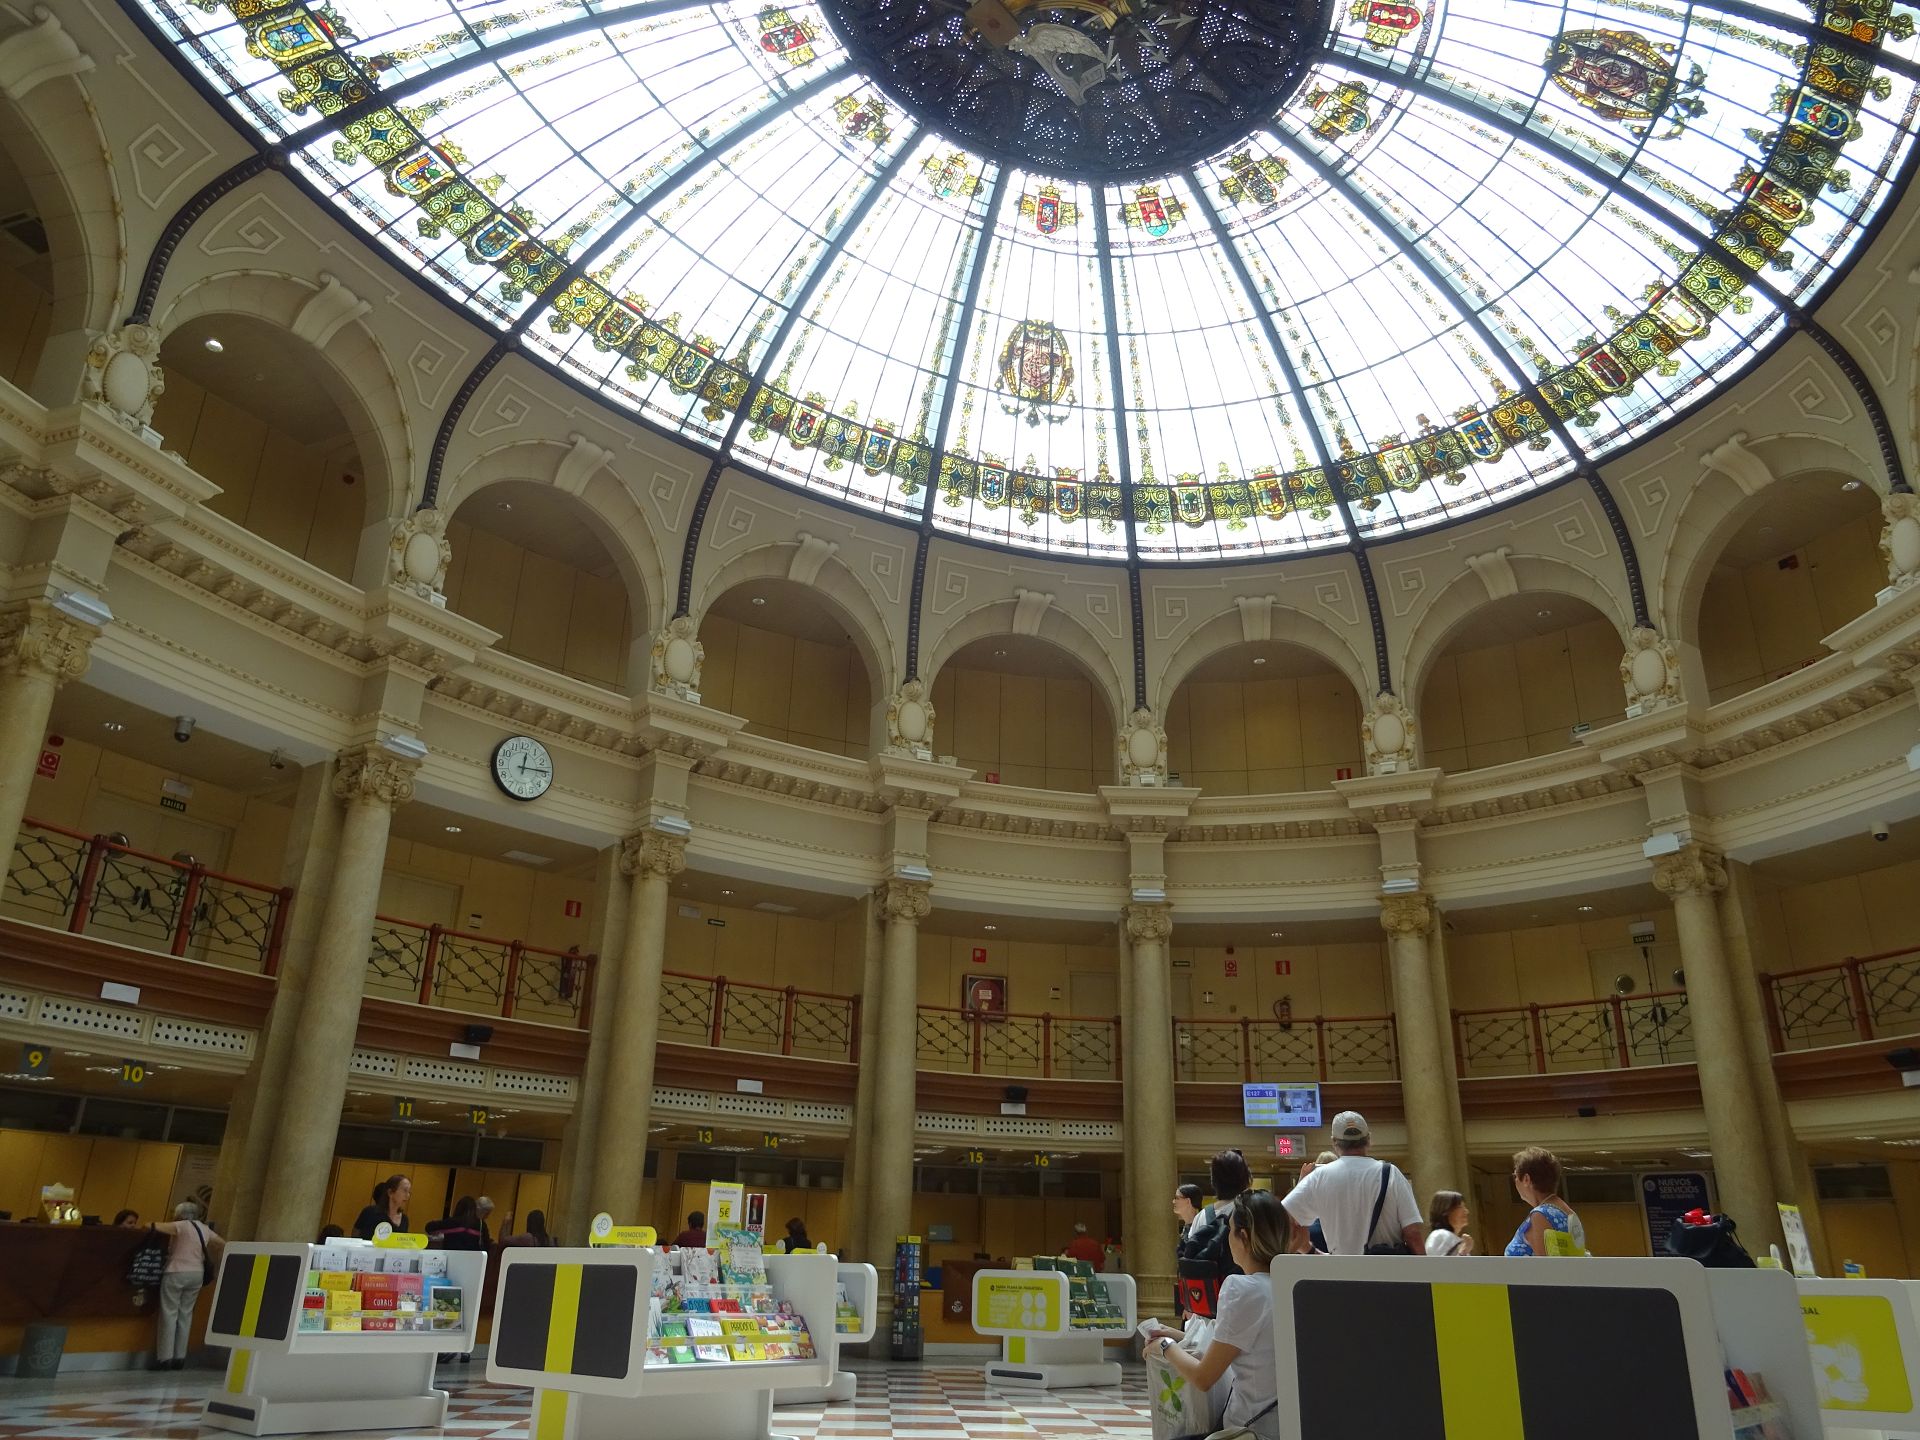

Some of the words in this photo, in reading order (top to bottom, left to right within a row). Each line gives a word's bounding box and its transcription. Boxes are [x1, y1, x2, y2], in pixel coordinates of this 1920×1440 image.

[511, 743, 518, 751] 11
[521, 742, 529, 750] 12
[503, 749, 511, 757] 10
[29, 1051, 43, 1068] 9
[123, 1064, 144, 1082] 10
[399, 1103, 412, 1116] 11
[472, 1110, 487, 1124] 12
[698, 1130, 713, 1143] 13
[764, 1135, 778, 1148] 14
[969, 1151, 984, 1164] 15
[1034, 1154, 1049, 1167] 16
[1658, 1178, 1691, 1186] NUEVOS
[1659, 1186, 1700, 1194] SERVICIOS
[719, 1207, 730, 1218] 5€
